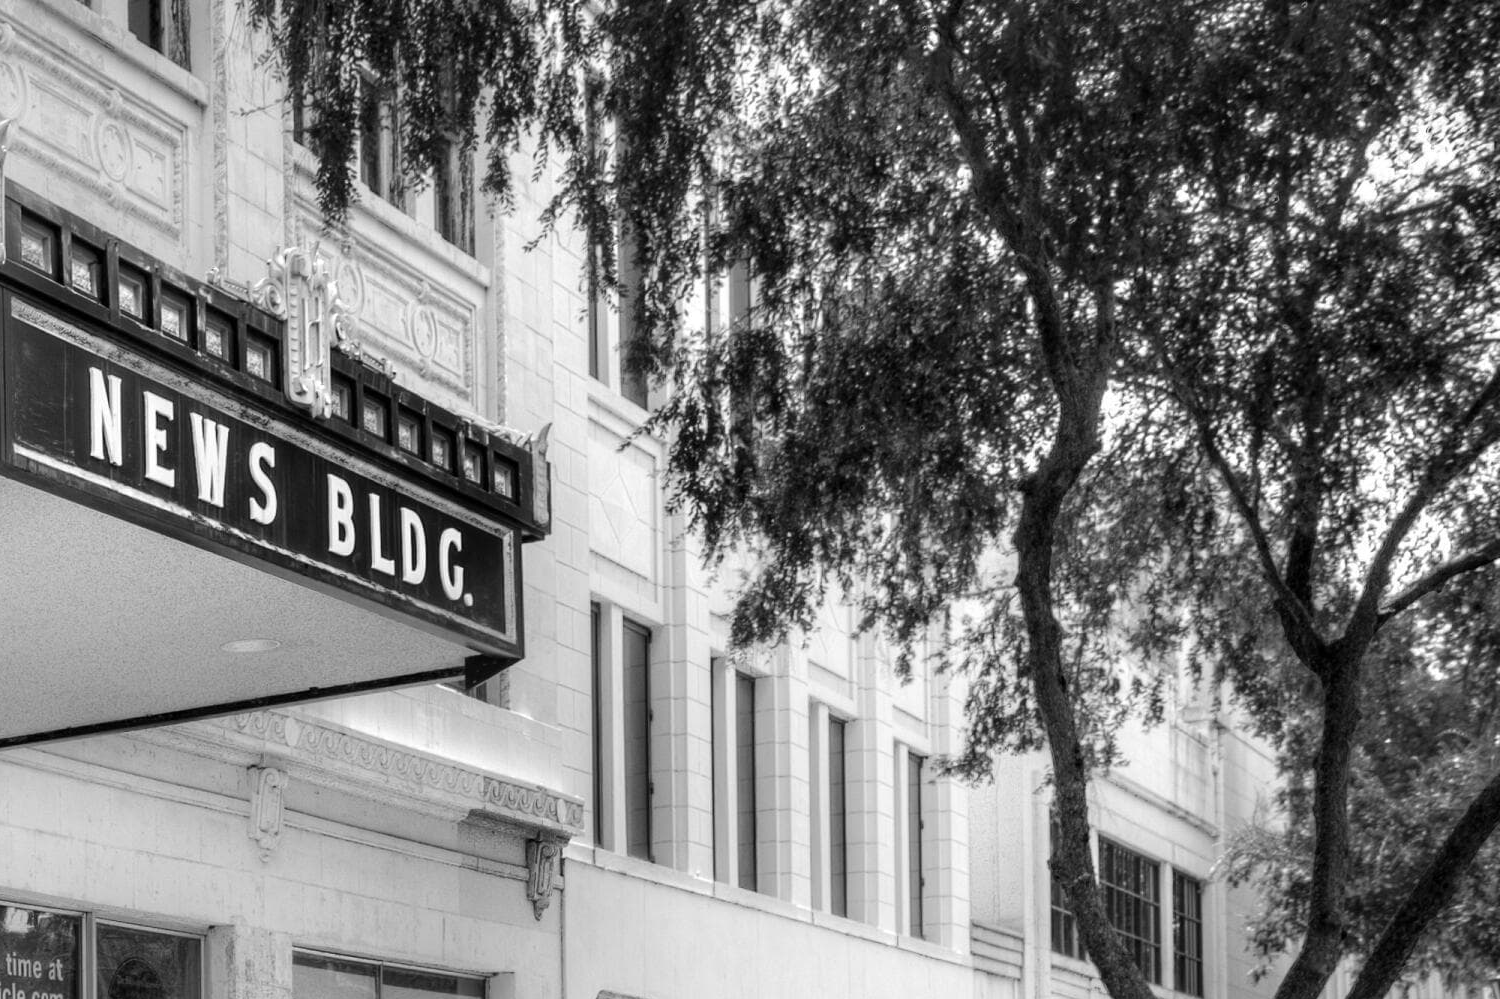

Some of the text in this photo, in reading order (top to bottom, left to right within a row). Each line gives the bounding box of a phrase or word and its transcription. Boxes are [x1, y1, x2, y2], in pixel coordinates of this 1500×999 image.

[88, 366, 474, 606] NEWS BLDG.
[6, 951, 43, 979] time
[48, 958, 64, 982] at
